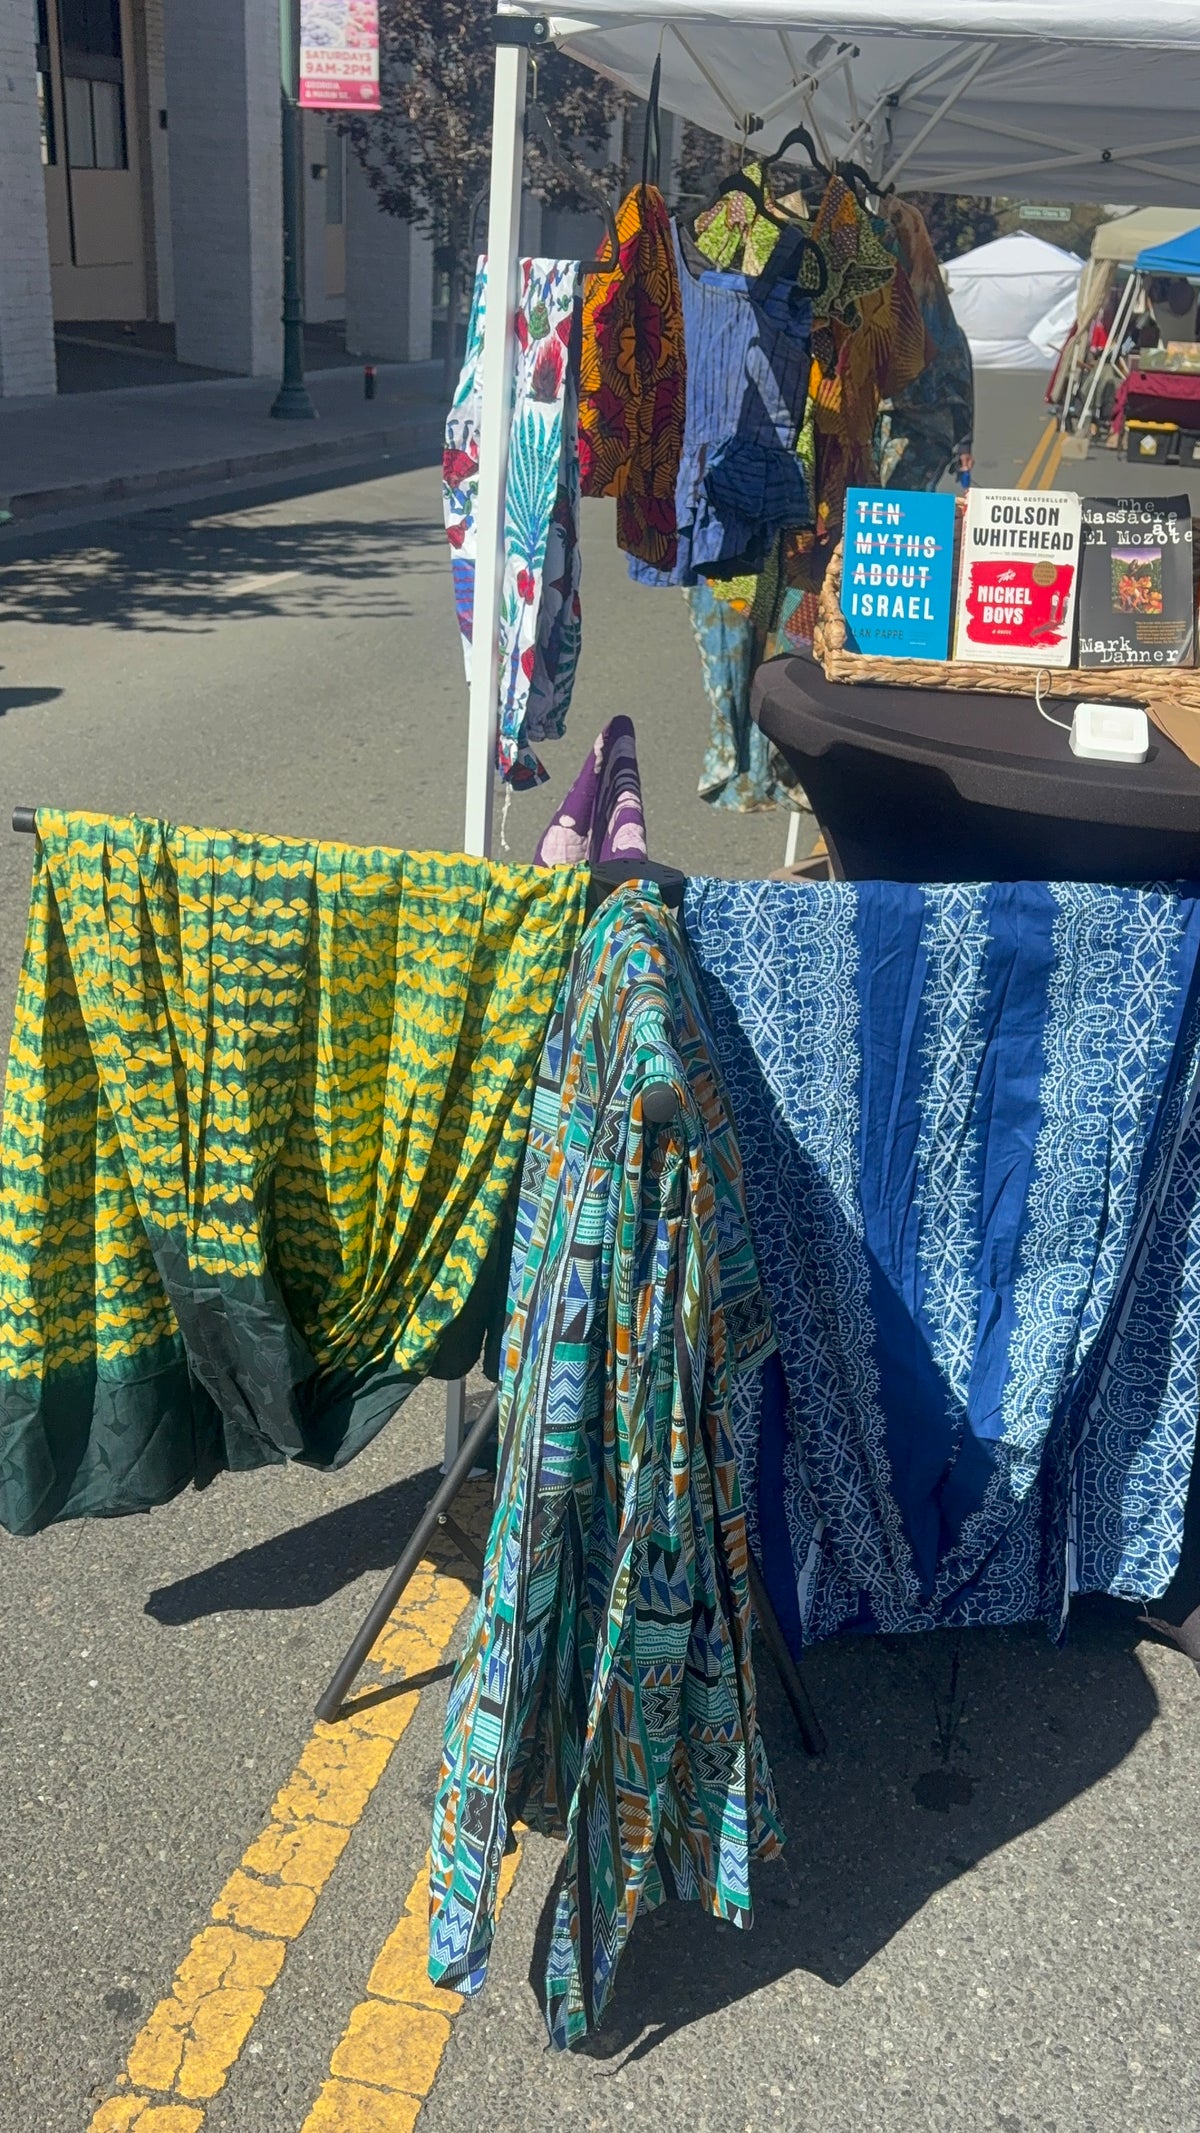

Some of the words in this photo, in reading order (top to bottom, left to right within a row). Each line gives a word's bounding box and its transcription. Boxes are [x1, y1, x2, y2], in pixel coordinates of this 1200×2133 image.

[305, 50, 372, 62] SATURDAYS
[306, 62, 372, 75] 9AM-2PM
[858, 500, 900, 526] TEN
[1117, 498, 1155, 513] The
[991, 505, 1060, 526] COLSON
[1081, 508, 1178, 524] Massacre
[1083, 530, 1107, 545] El
[1117, 528, 1193, 545] Mozote
[1152, 521, 1176, 536] at
[856, 531, 936, 559] MYTHS
[973, 527, 1074, 551] WHITEHEAD
[853, 562, 930, 589] ABOUT
[977, 585, 1032, 605] NICKEL
[851, 593, 935, 620] ISRAEL
[983, 606, 1024, 625] BOYS
[851, 627, 872, 639] LAN
[1080, 636, 1132, 653] Mark
[1100, 648, 1179, 663] Danner
